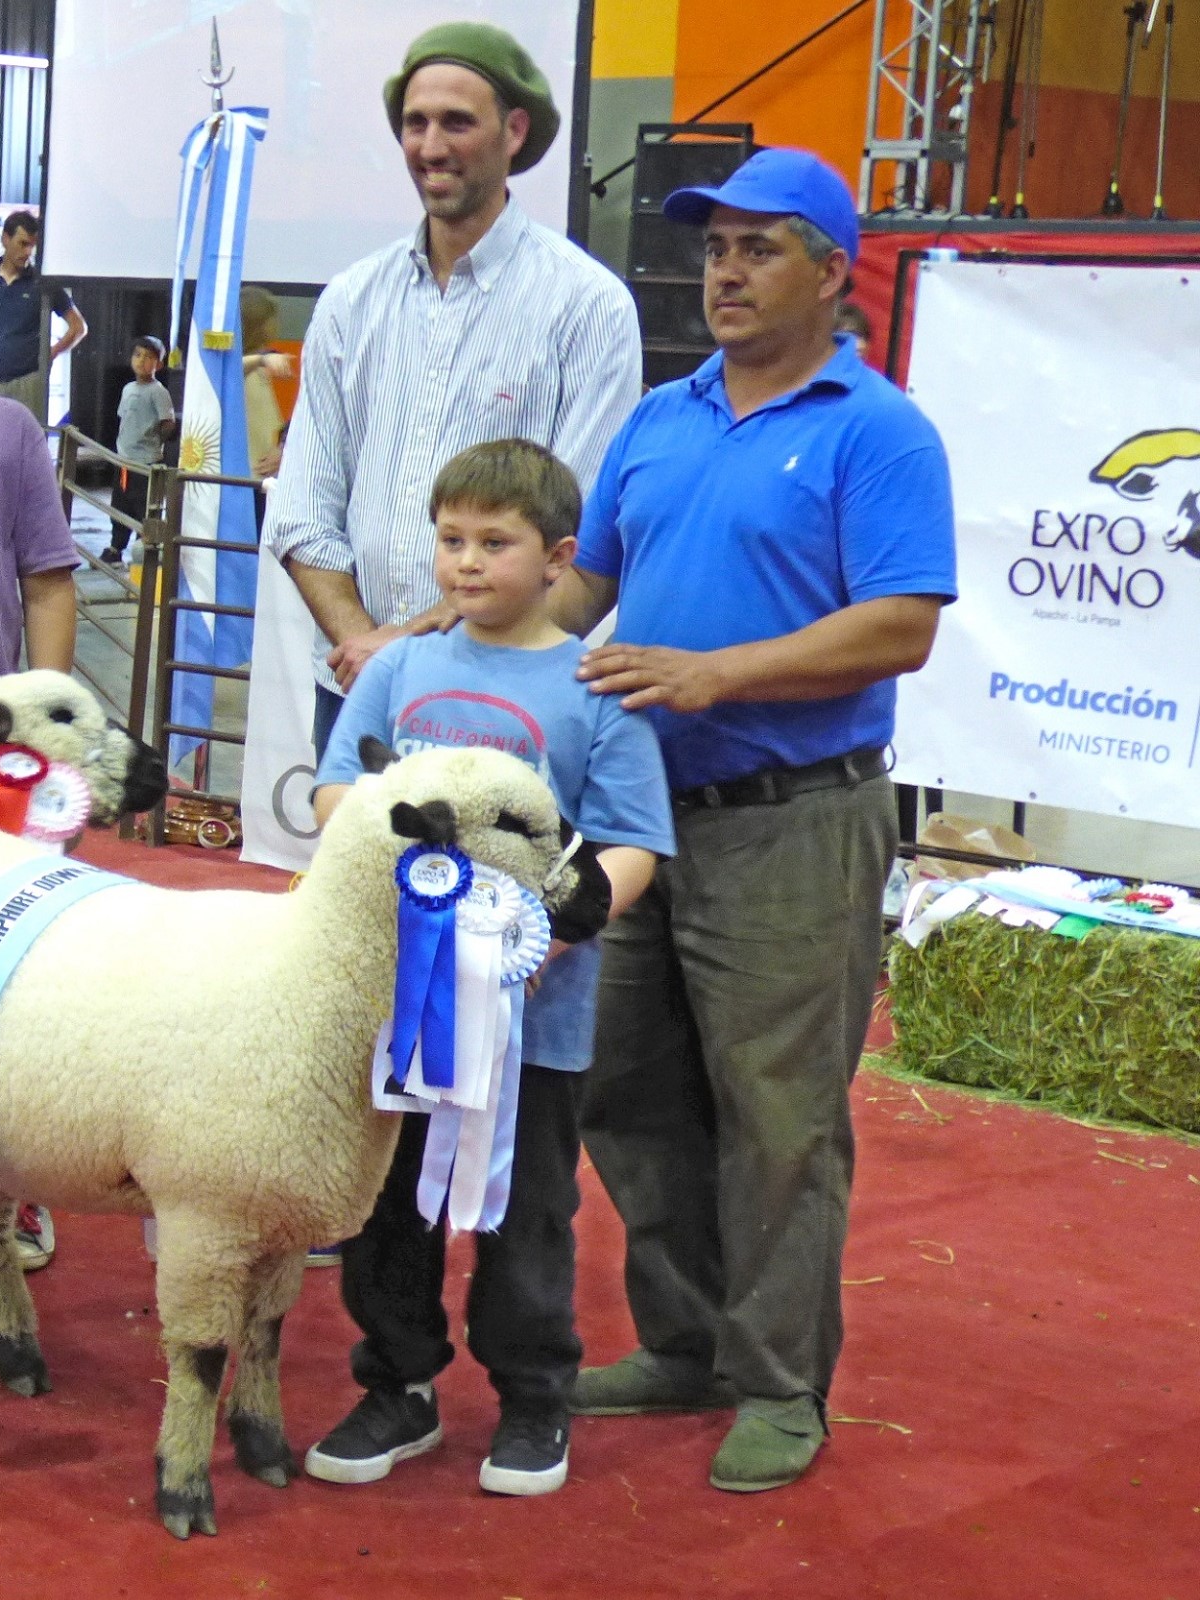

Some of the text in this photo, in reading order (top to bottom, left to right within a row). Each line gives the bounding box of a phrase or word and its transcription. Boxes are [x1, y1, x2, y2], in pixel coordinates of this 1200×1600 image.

[1031, 509, 1146, 556] EXPO
[1007, 557, 1165, 609] OVINO
[989, 671, 1178, 722] Producción
[408, 717, 529, 755] CALIFORNIA
[1038, 729, 1171, 765] MINISTERIO
